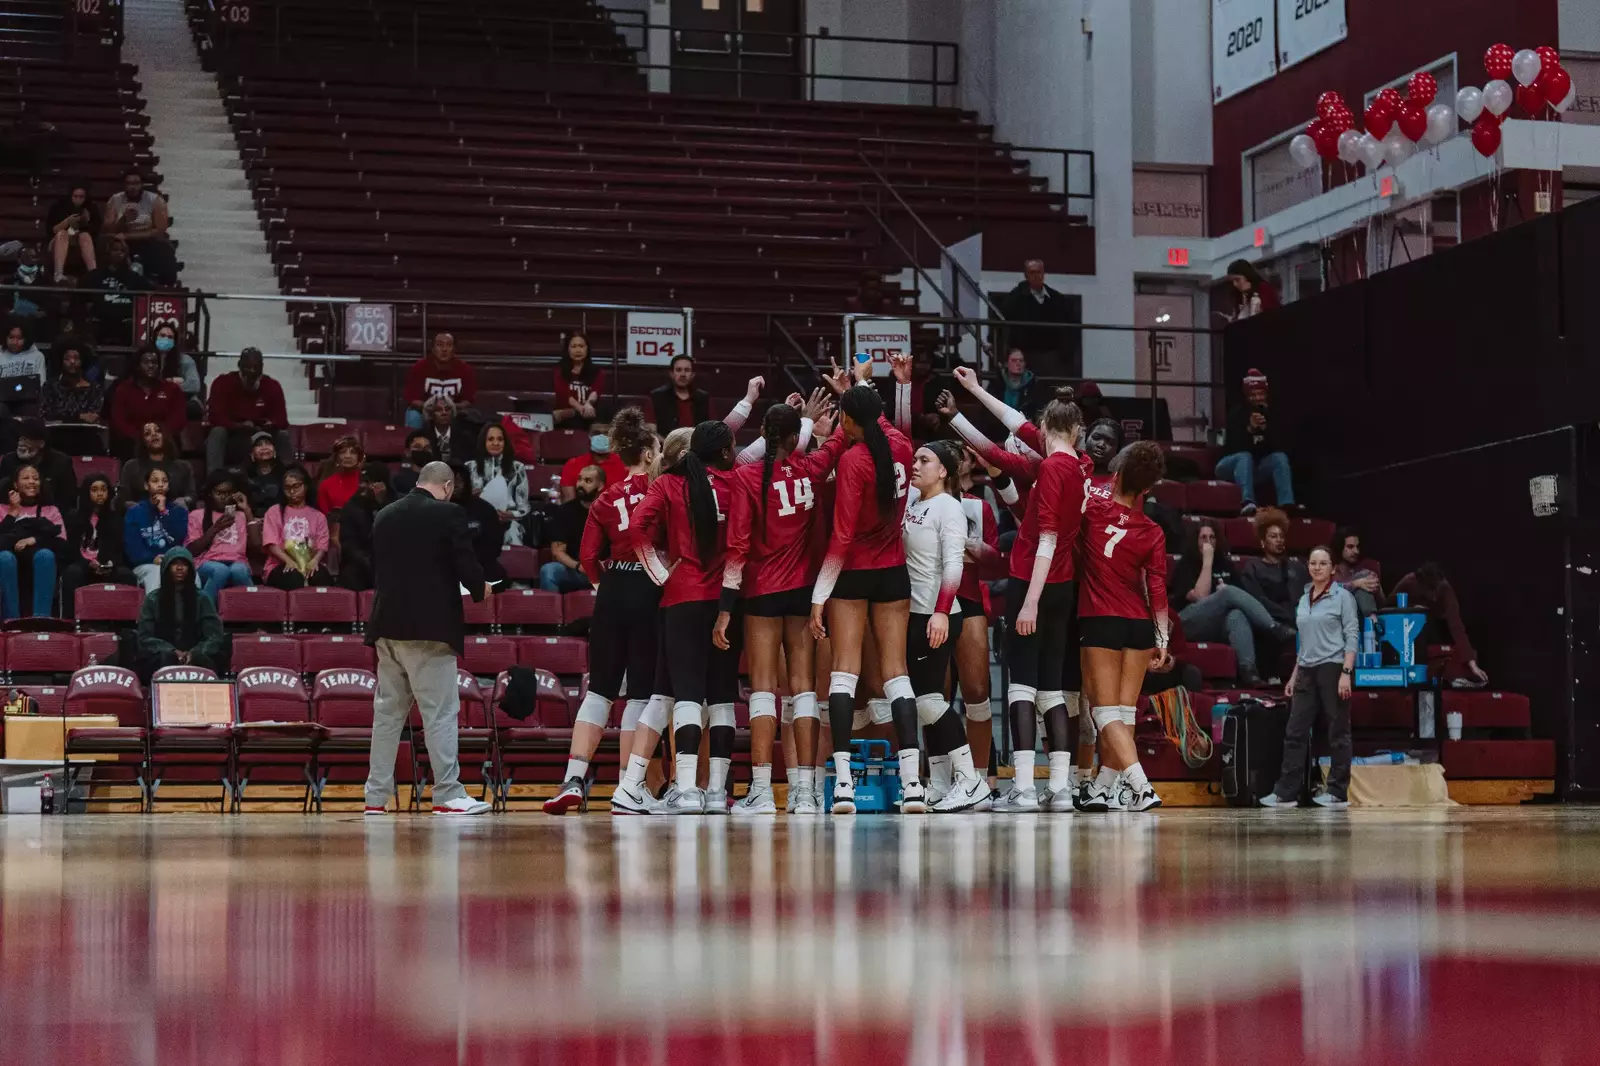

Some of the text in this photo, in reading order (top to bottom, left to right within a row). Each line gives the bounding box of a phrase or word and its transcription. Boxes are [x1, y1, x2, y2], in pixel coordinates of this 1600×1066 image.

[1295, 0, 1330, 20] 20
[1227, 17, 1262, 57] 2020
[355, 307, 384, 319] SEC.
[351, 322, 388, 345] 203
[630, 326, 682, 336] SECTION
[858, 334, 908, 342] SECTION
[635, 341, 675, 357] 104
[773, 477, 815, 517] 14
[1103, 524, 1128, 558] 7
[75, 671, 134, 688] TEMPLE
[241, 672, 298, 688] TEMPLE
[320, 673, 376, 689] TEMPLE
